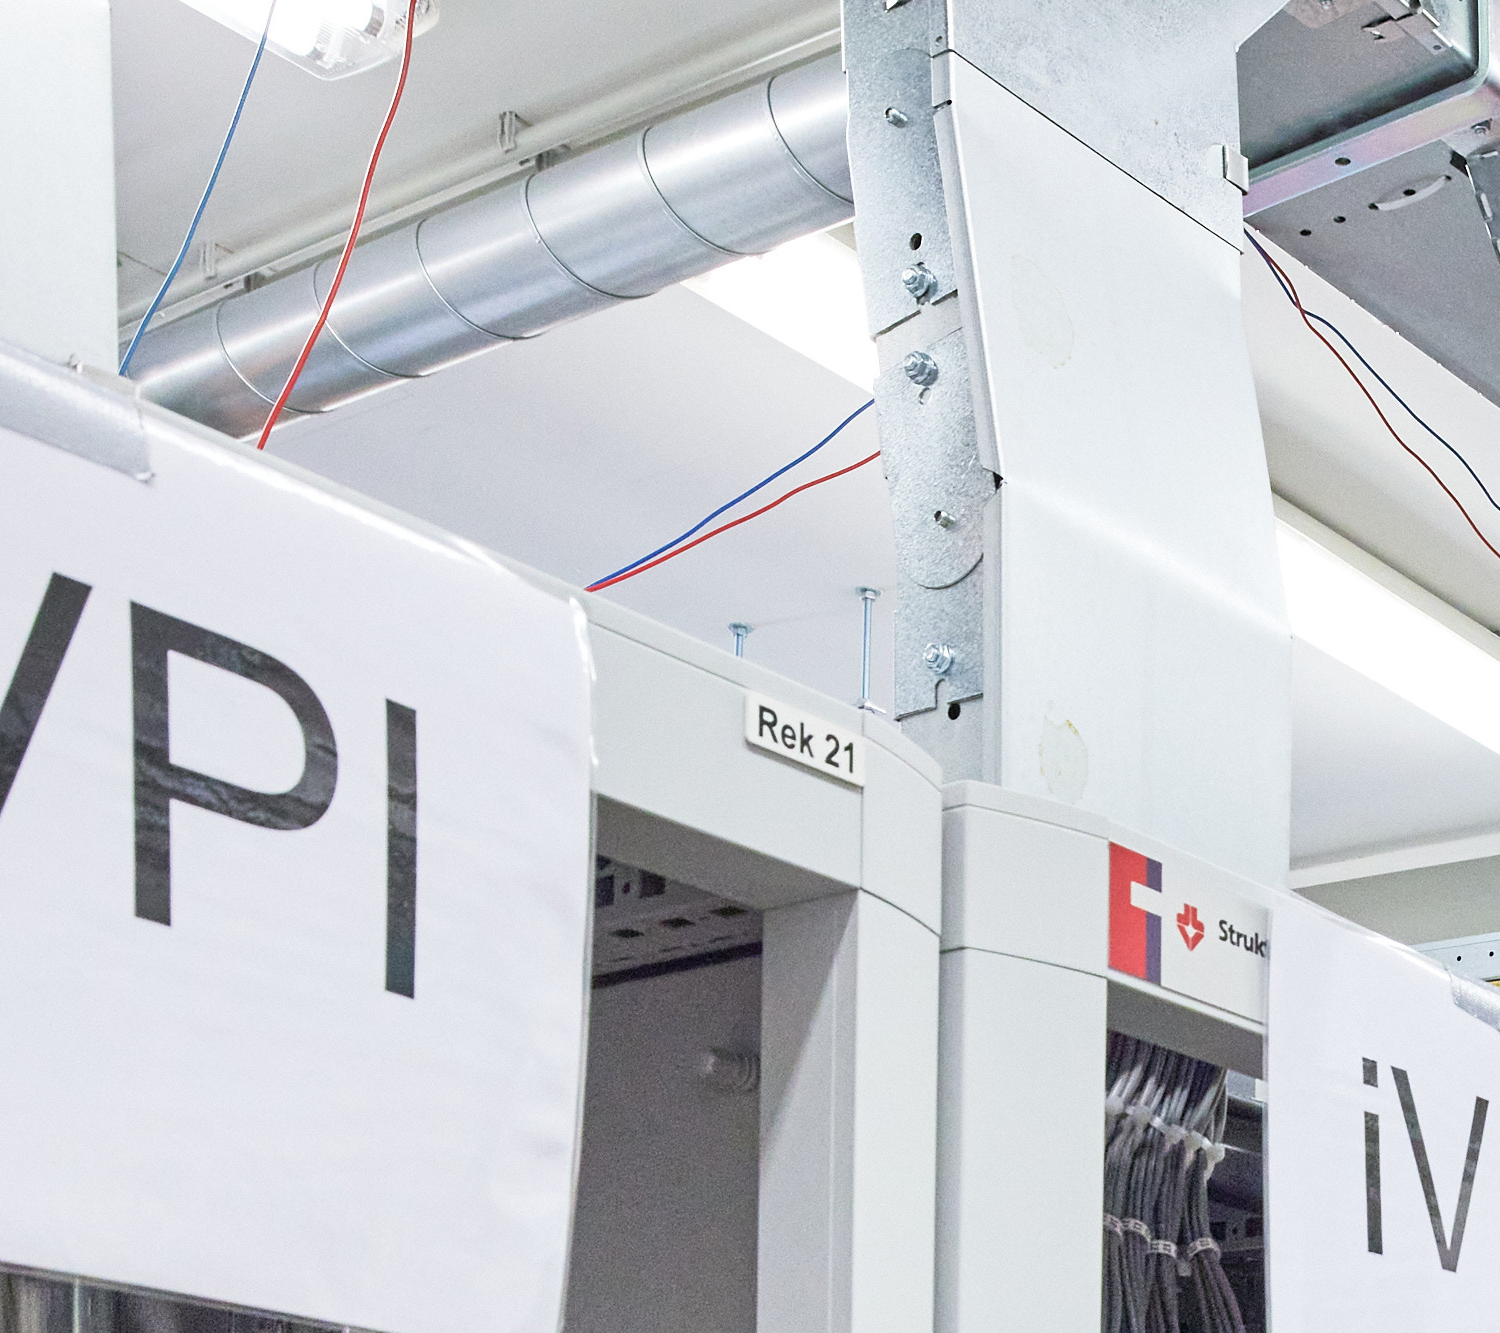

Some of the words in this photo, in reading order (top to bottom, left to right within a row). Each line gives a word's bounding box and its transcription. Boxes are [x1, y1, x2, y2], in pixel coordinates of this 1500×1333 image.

[757, 704, 814, 758] Rek
[825, 733, 858, 774] 21
[1219, 918, 1267, 961] Struk
